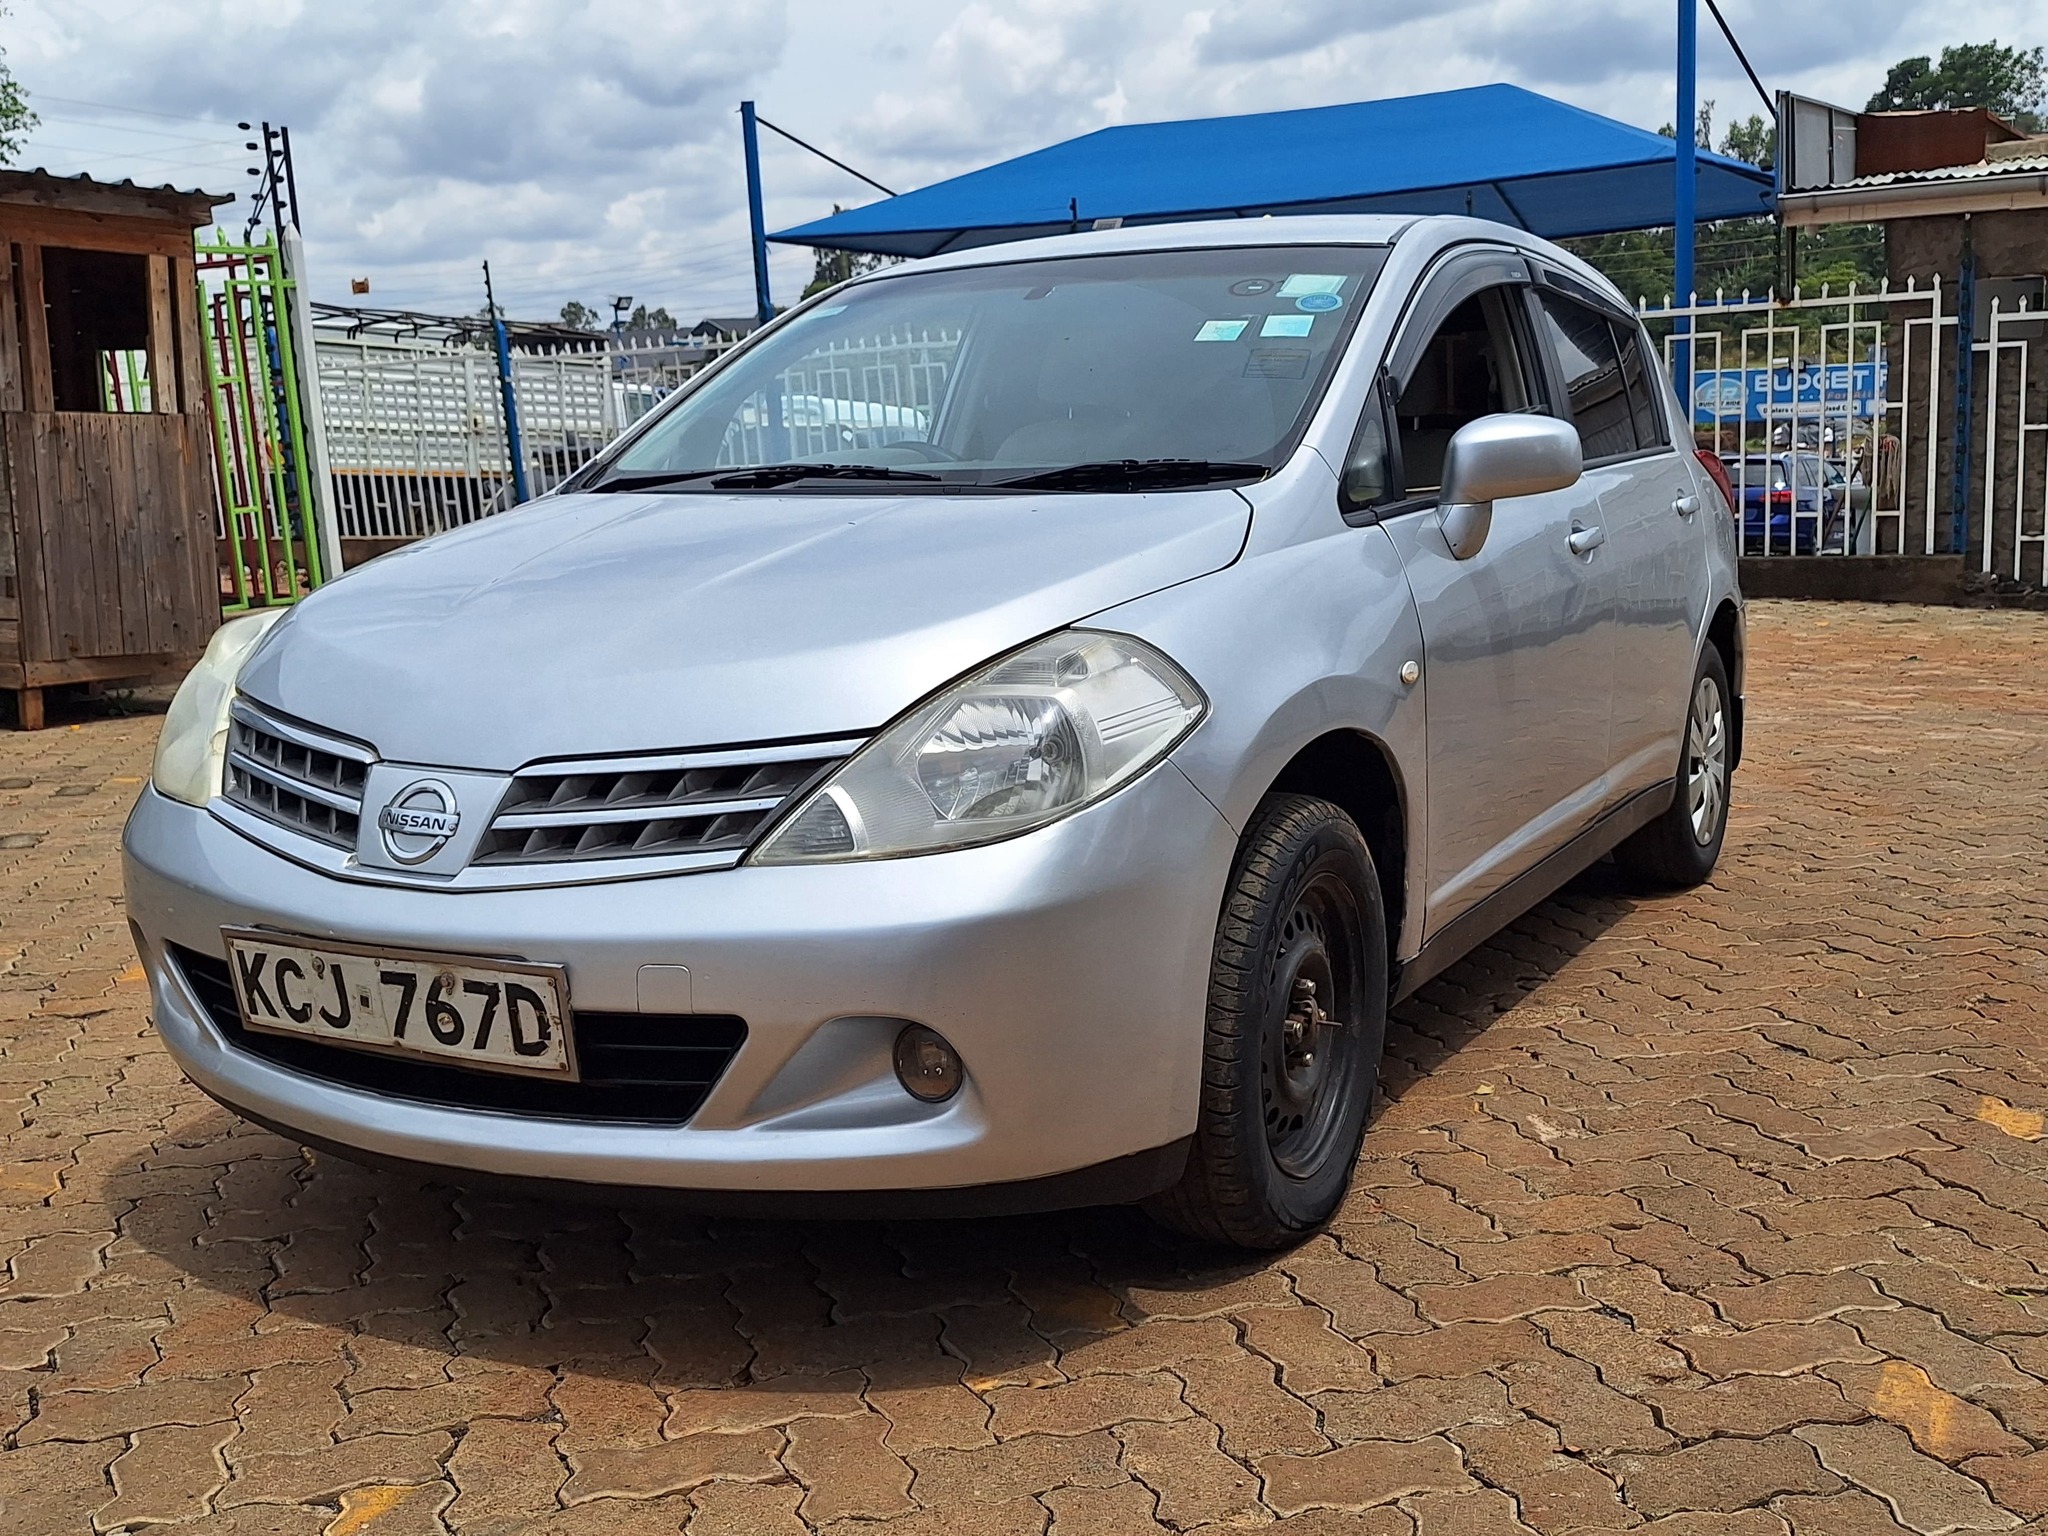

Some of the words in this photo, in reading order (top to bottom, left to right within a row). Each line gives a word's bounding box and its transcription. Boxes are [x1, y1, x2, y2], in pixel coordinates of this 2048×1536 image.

[1754, 369, 1870, 392] BUDGET
[384, 811, 447, 831] NISSAN
[236, 949, 351, 1029] KCJ
[380, 970, 552, 1057] 767D
